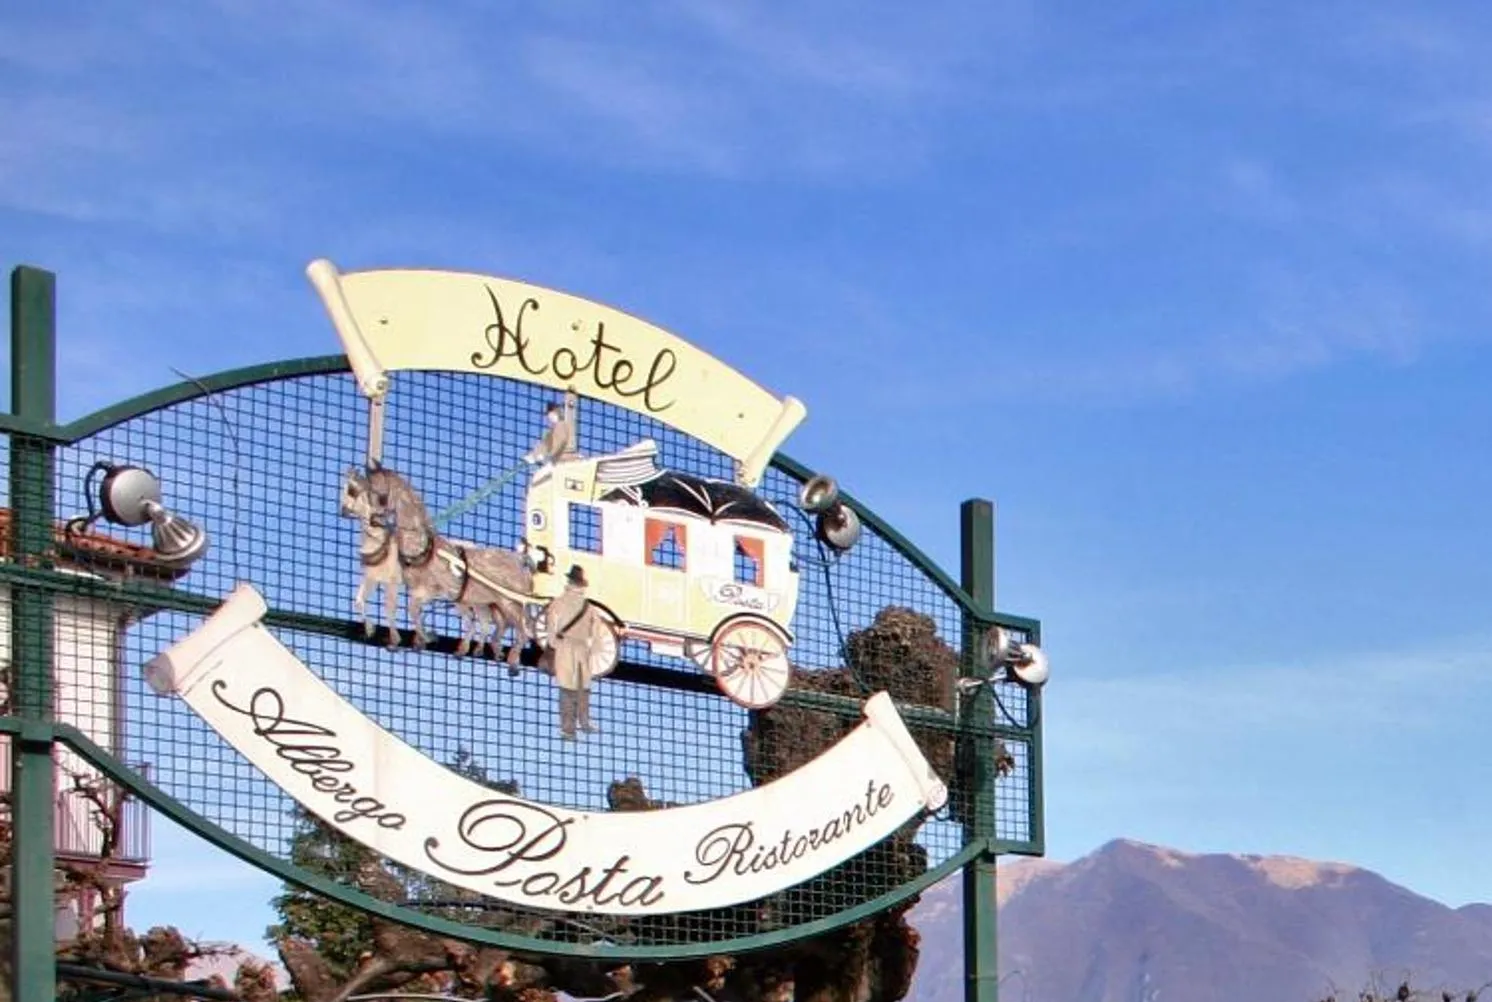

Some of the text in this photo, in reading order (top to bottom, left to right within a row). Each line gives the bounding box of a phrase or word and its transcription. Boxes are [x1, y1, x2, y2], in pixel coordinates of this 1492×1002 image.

[471, 284, 677, 412] Hotel
[211, 679, 894, 908] Albergo Posta Ristorante
